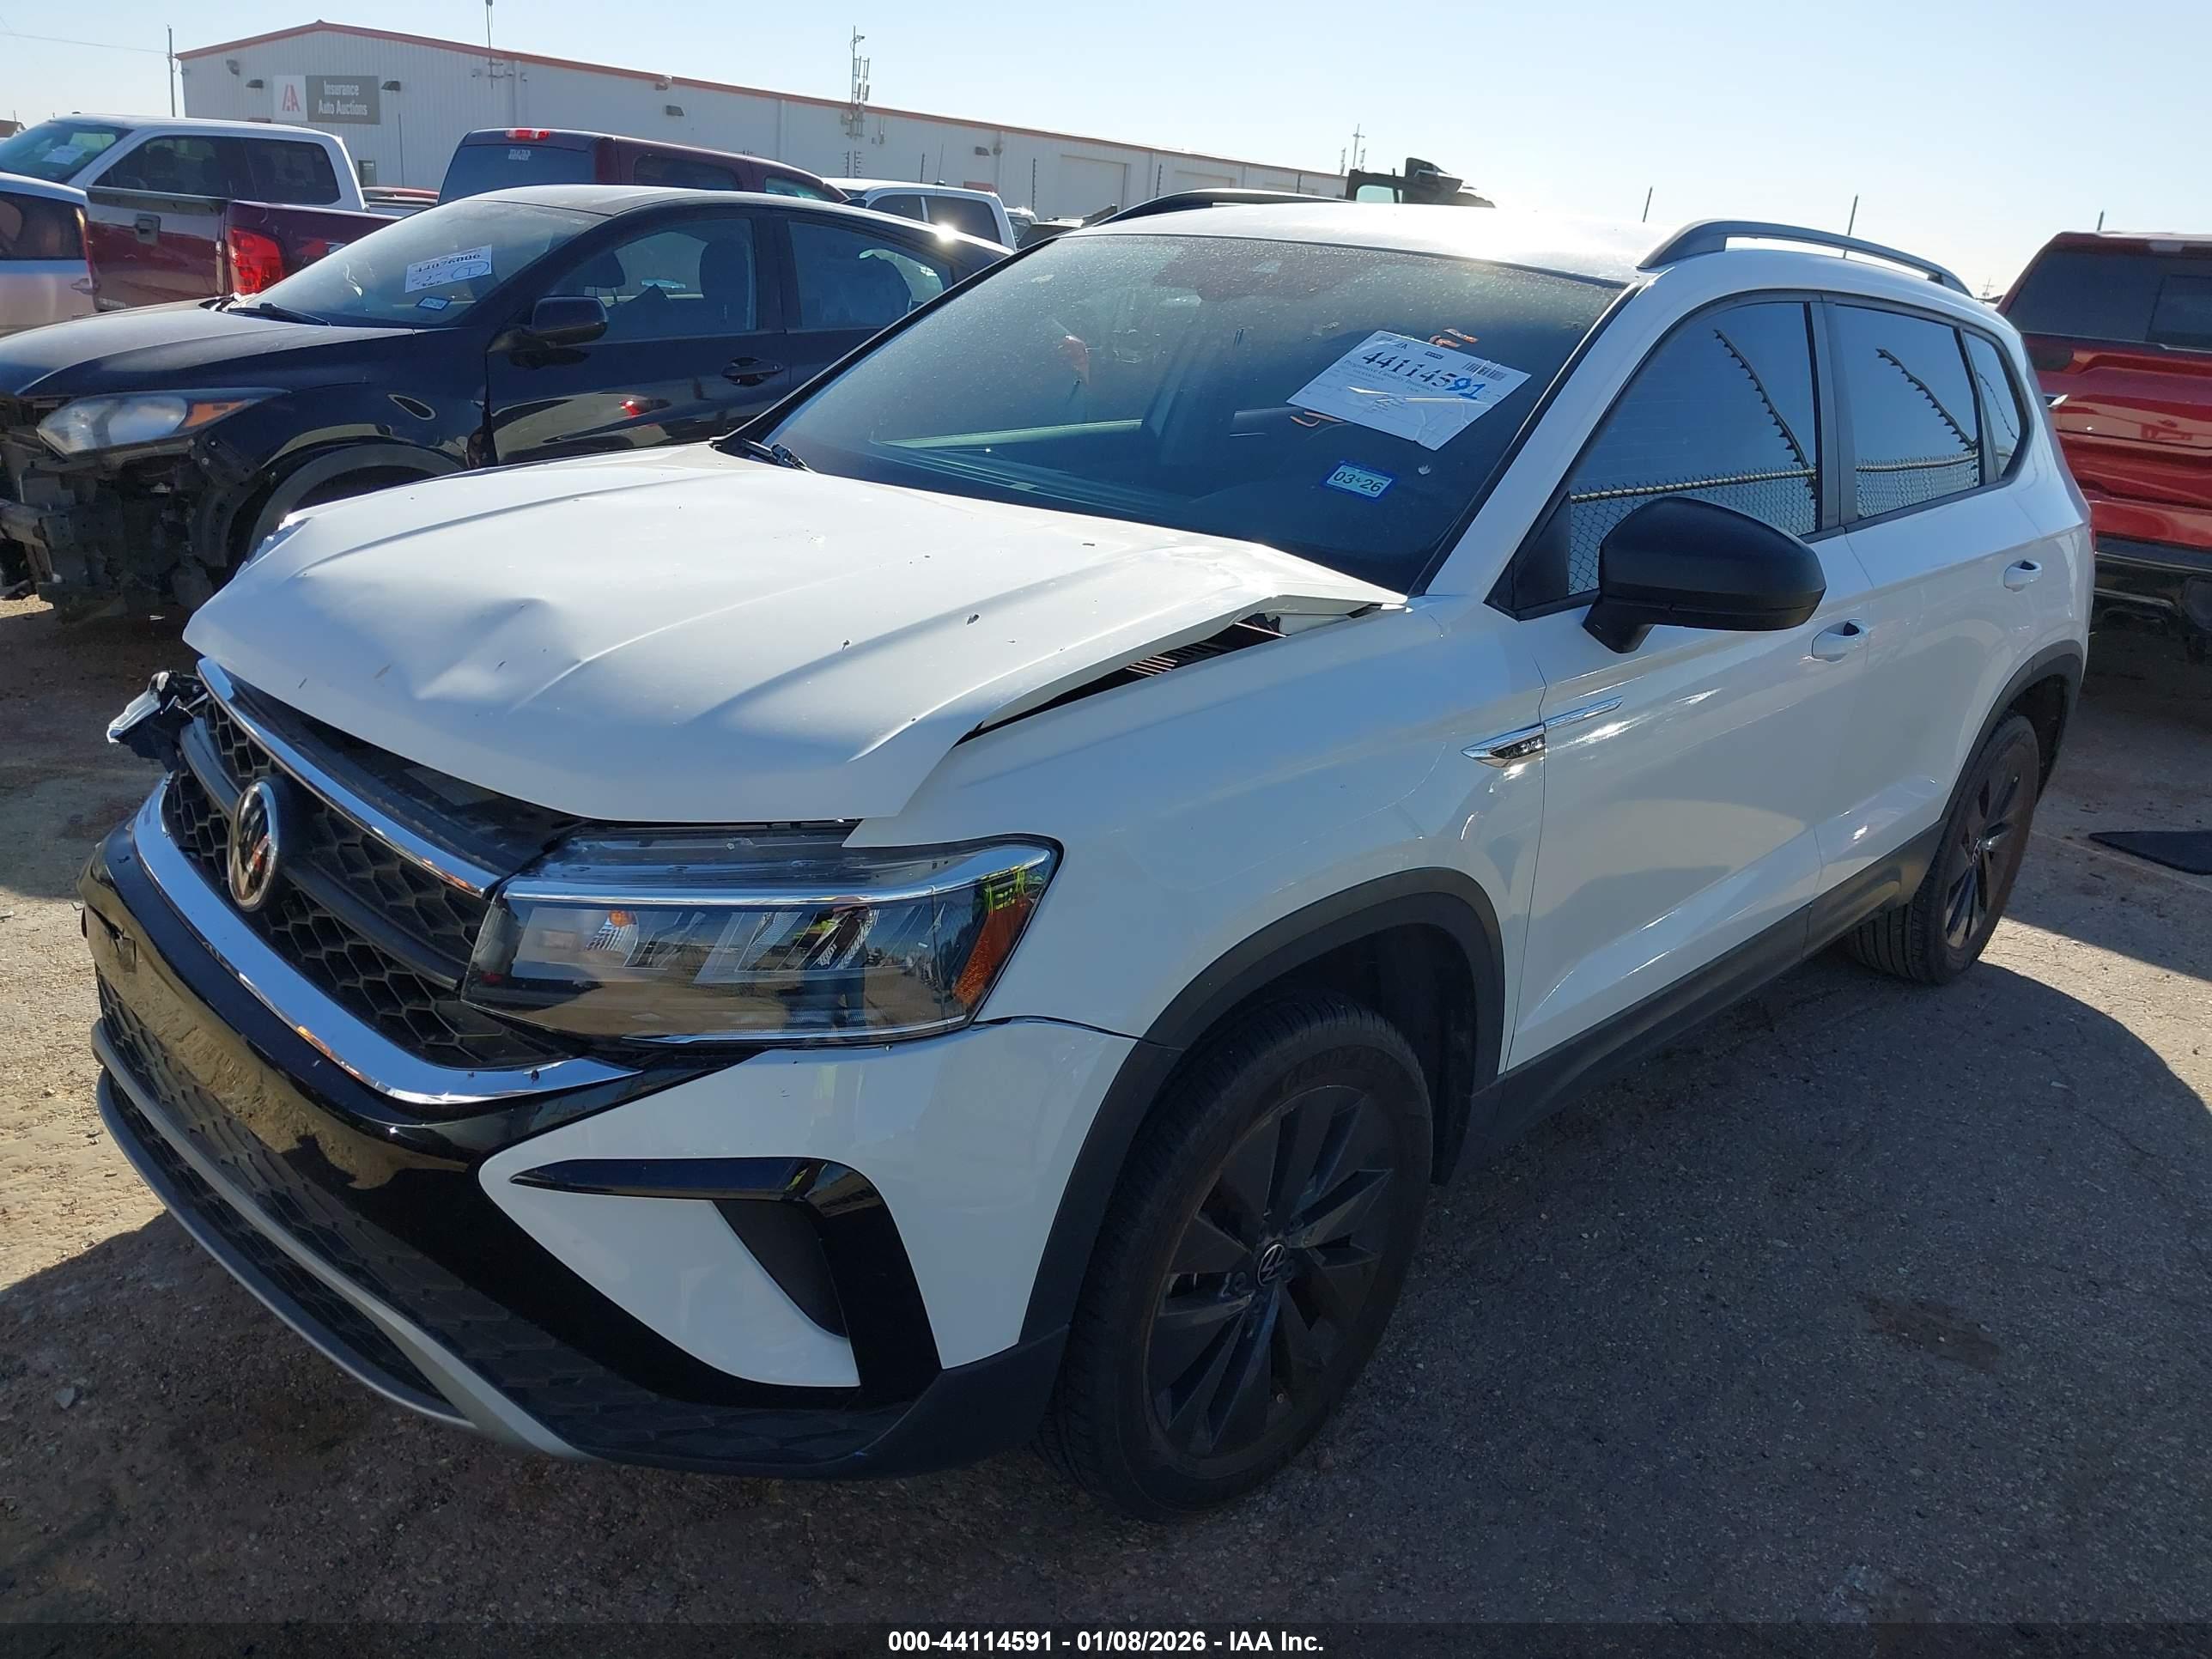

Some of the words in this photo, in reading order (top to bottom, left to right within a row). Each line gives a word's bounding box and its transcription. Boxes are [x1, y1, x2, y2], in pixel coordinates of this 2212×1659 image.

[323, 80, 360, 97] Insurance
[318, 99, 335, 115] Auto
[336, 99, 368, 117] Auctions
[1362, 351, 1487, 400] 44114591
